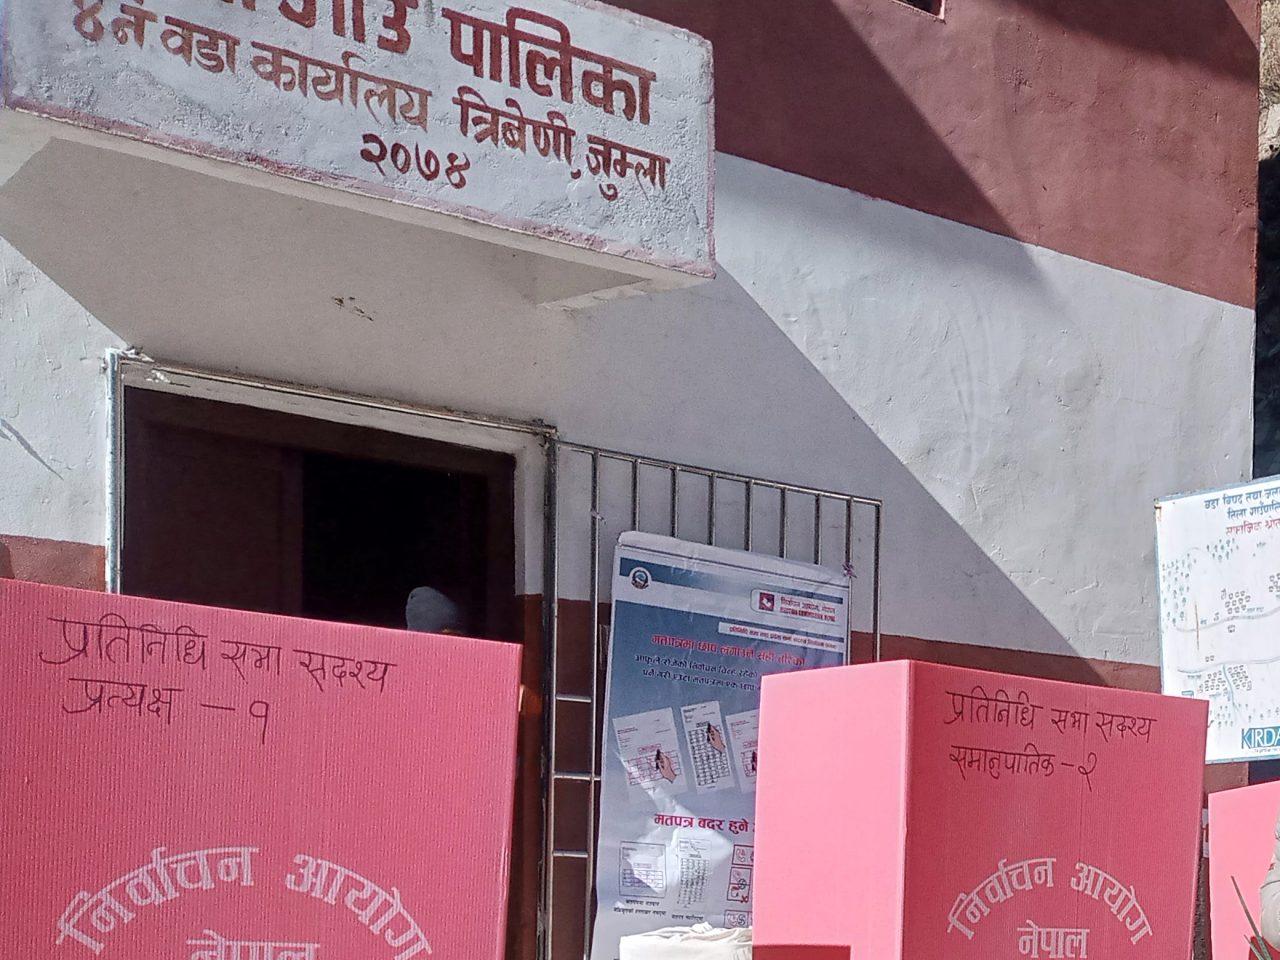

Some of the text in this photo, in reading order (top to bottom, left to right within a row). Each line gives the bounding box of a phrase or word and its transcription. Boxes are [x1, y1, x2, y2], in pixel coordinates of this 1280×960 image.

[441, 7, 656, 125] पालिका
[160, 15, 240, 74] वडा
[251, 50, 432, 133] कार्यालय
[586, 134, 670, 201] जुम्ला
[360, 133, 470, 189] २०७४
[39, 613, 208, 670] प्रतिनिधि
[221, 640, 282, 680] सभा
[62, 678, 184, 725] प्रत्यक्ष
[944, 685, 1044, 730] प्रतिनिधि
[1051, 708, 1089, 735] सभा
[654, 812, 695, 828] मतपत्र
[698, 818, 725, 831] बदर
[728, 818, 750, 835] हुने
[56, 847, 258, 956] निर्वाचन
[947, 857, 1152, 945] निर्वाचन आयोग
[1017, 920, 1090, 959] नेपाल
